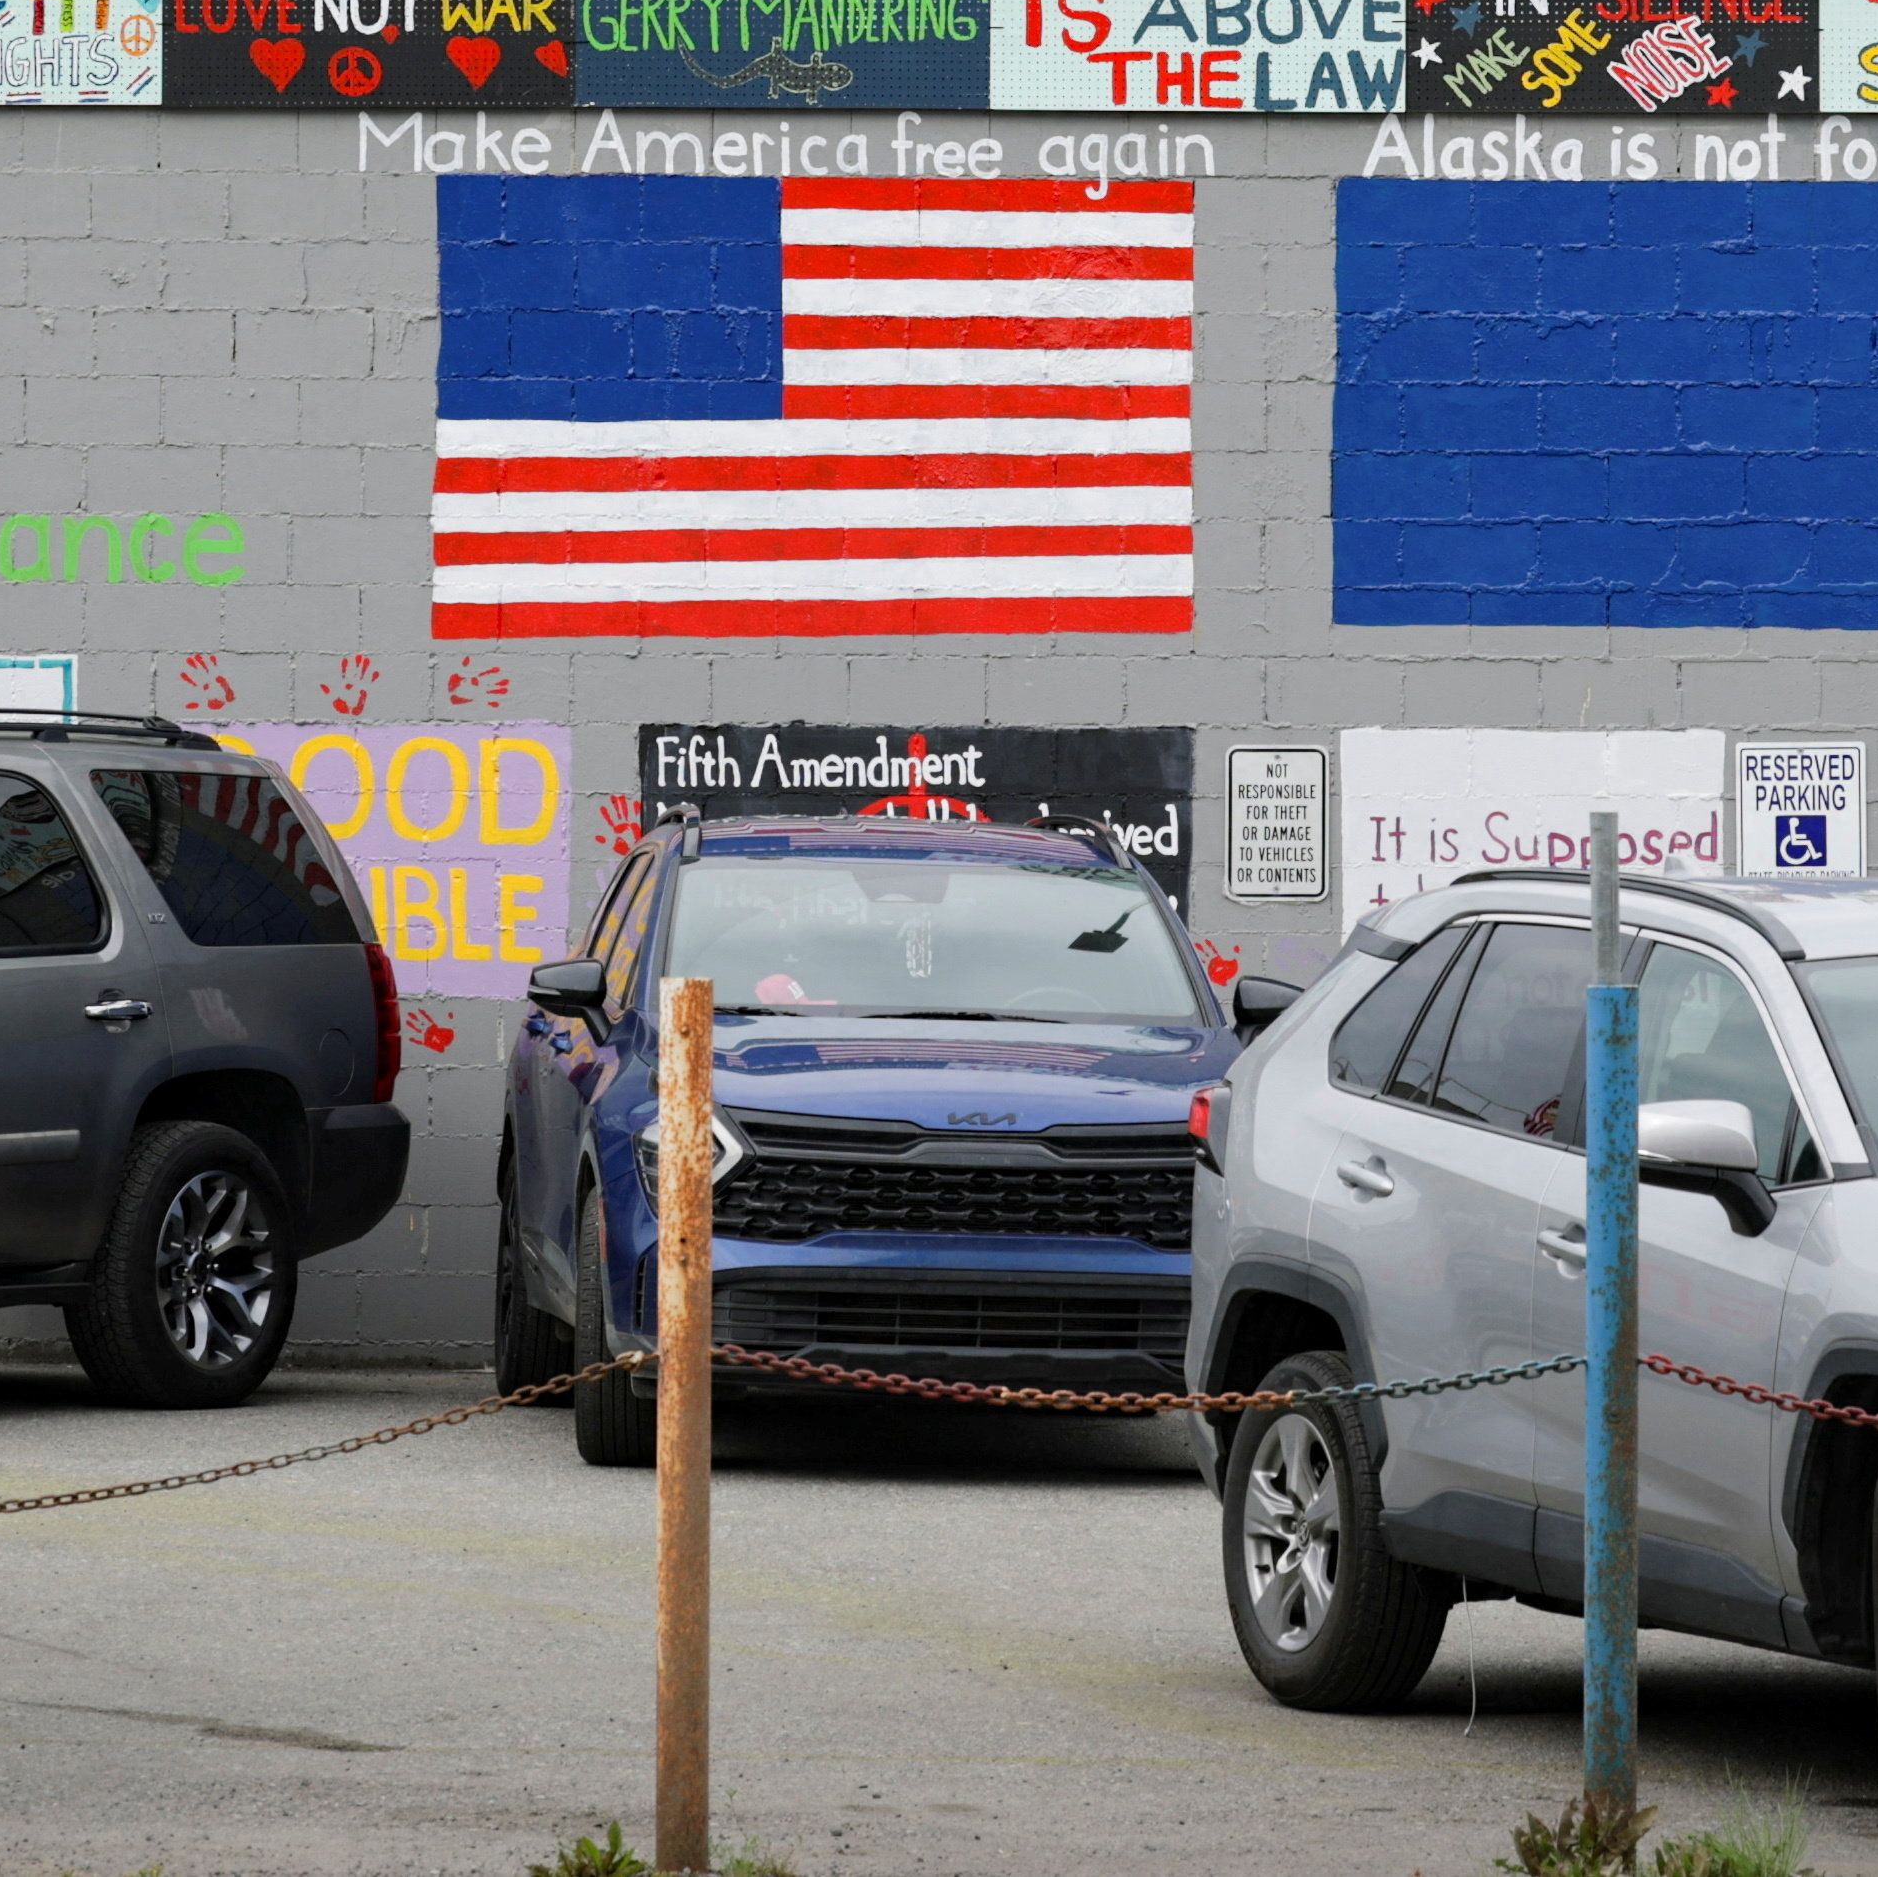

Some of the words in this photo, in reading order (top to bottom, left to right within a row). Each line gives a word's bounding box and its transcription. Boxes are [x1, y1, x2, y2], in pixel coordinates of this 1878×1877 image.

[1442, 27, 1531, 107] MAKE
[1521, 8, 1612, 108] SOME
[1607, 15, 1733, 112] NOISE
[1086, 50, 1244, 109] THE
[1253, 49, 1405, 112] LAW
[357, 108, 553, 178] Make
[580, 107, 870, 178] America
[890, 111, 1004, 180] free
[1038, 122, 1217, 202] again
[1361, 112, 1584, 182] Alaska
[1608, 125, 1673, 181] is
[1694, 112, 1787, 182] not
[656, 734, 742, 788] Fifth
[750, 733, 987, 789] Amendment
[1266, 764, 1289, 778] NOT
[1746, 754, 1855, 781] RESERVED
[209, 733, 561, 846] OOD
[1238, 784, 1316, 799] RESPONSIBLE
[1756, 784, 1846, 811] PARKING
[1246, 805, 1269, 820] FOR
[1274, 805, 1308, 820] THEFT
[1242, 826, 1258, 841] OR
[1264, 826, 1312, 841] DAMAGE
[1369, 816, 1407, 862] It
[1428, 818, 1460, 863] is
[1240, 847, 1253, 862] TO
[1258, 847, 1314, 862] VEHICLES
[1237, 868, 1253, 883] OR
[1258, 868, 1317, 883] CONTENTS
